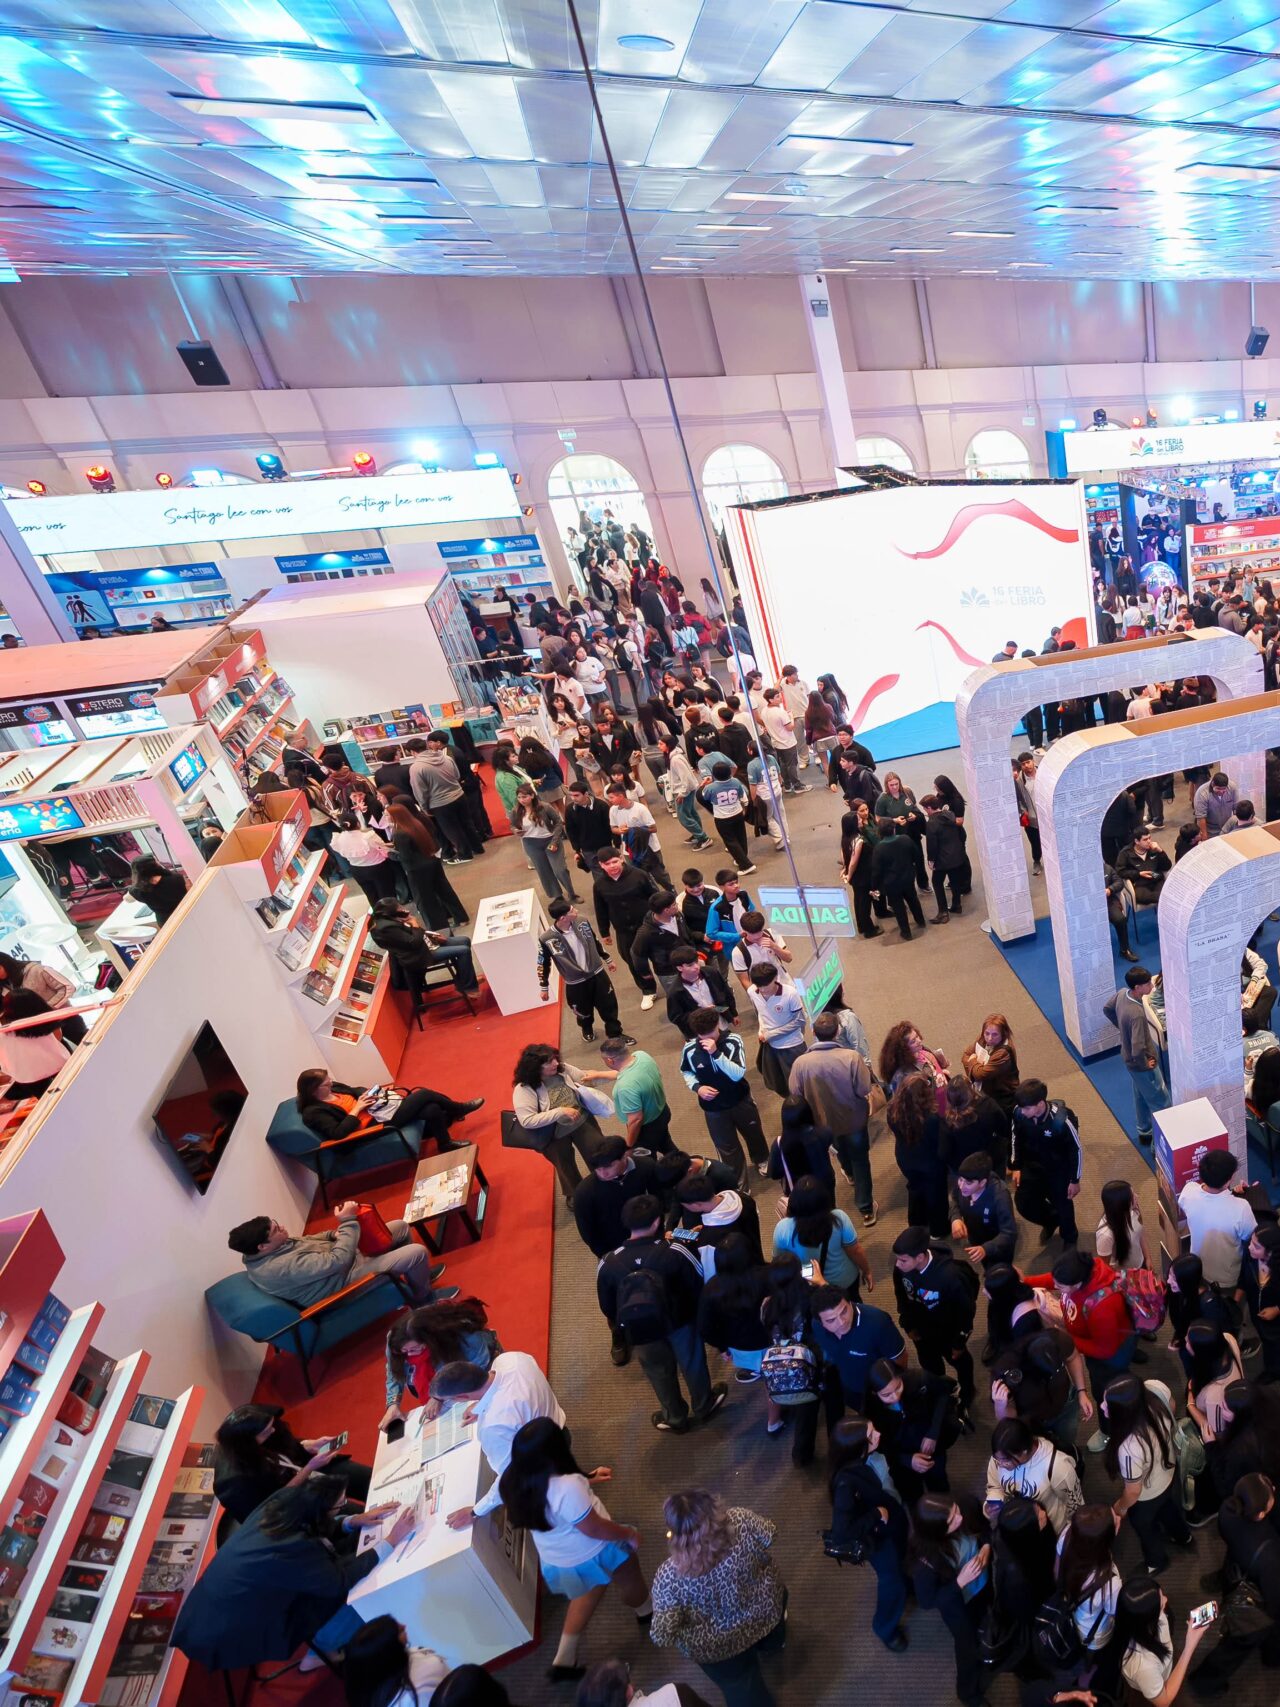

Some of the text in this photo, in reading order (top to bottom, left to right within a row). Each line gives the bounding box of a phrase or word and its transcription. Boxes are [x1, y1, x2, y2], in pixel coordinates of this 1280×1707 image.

[1164, 438, 1183, 446] FERIA
[1164, 444, 1185, 452] LIBRO
[338, 493, 454, 512] Santiago lee con vos
[163, 504, 294, 525] Santiago lee con vos
[46, 521, 67, 531] vos
[1008, 585, 1044, 596] FERIA
[1010, 595, 1047, 606] LIBRO
[717, 789, 739, 807] 26
